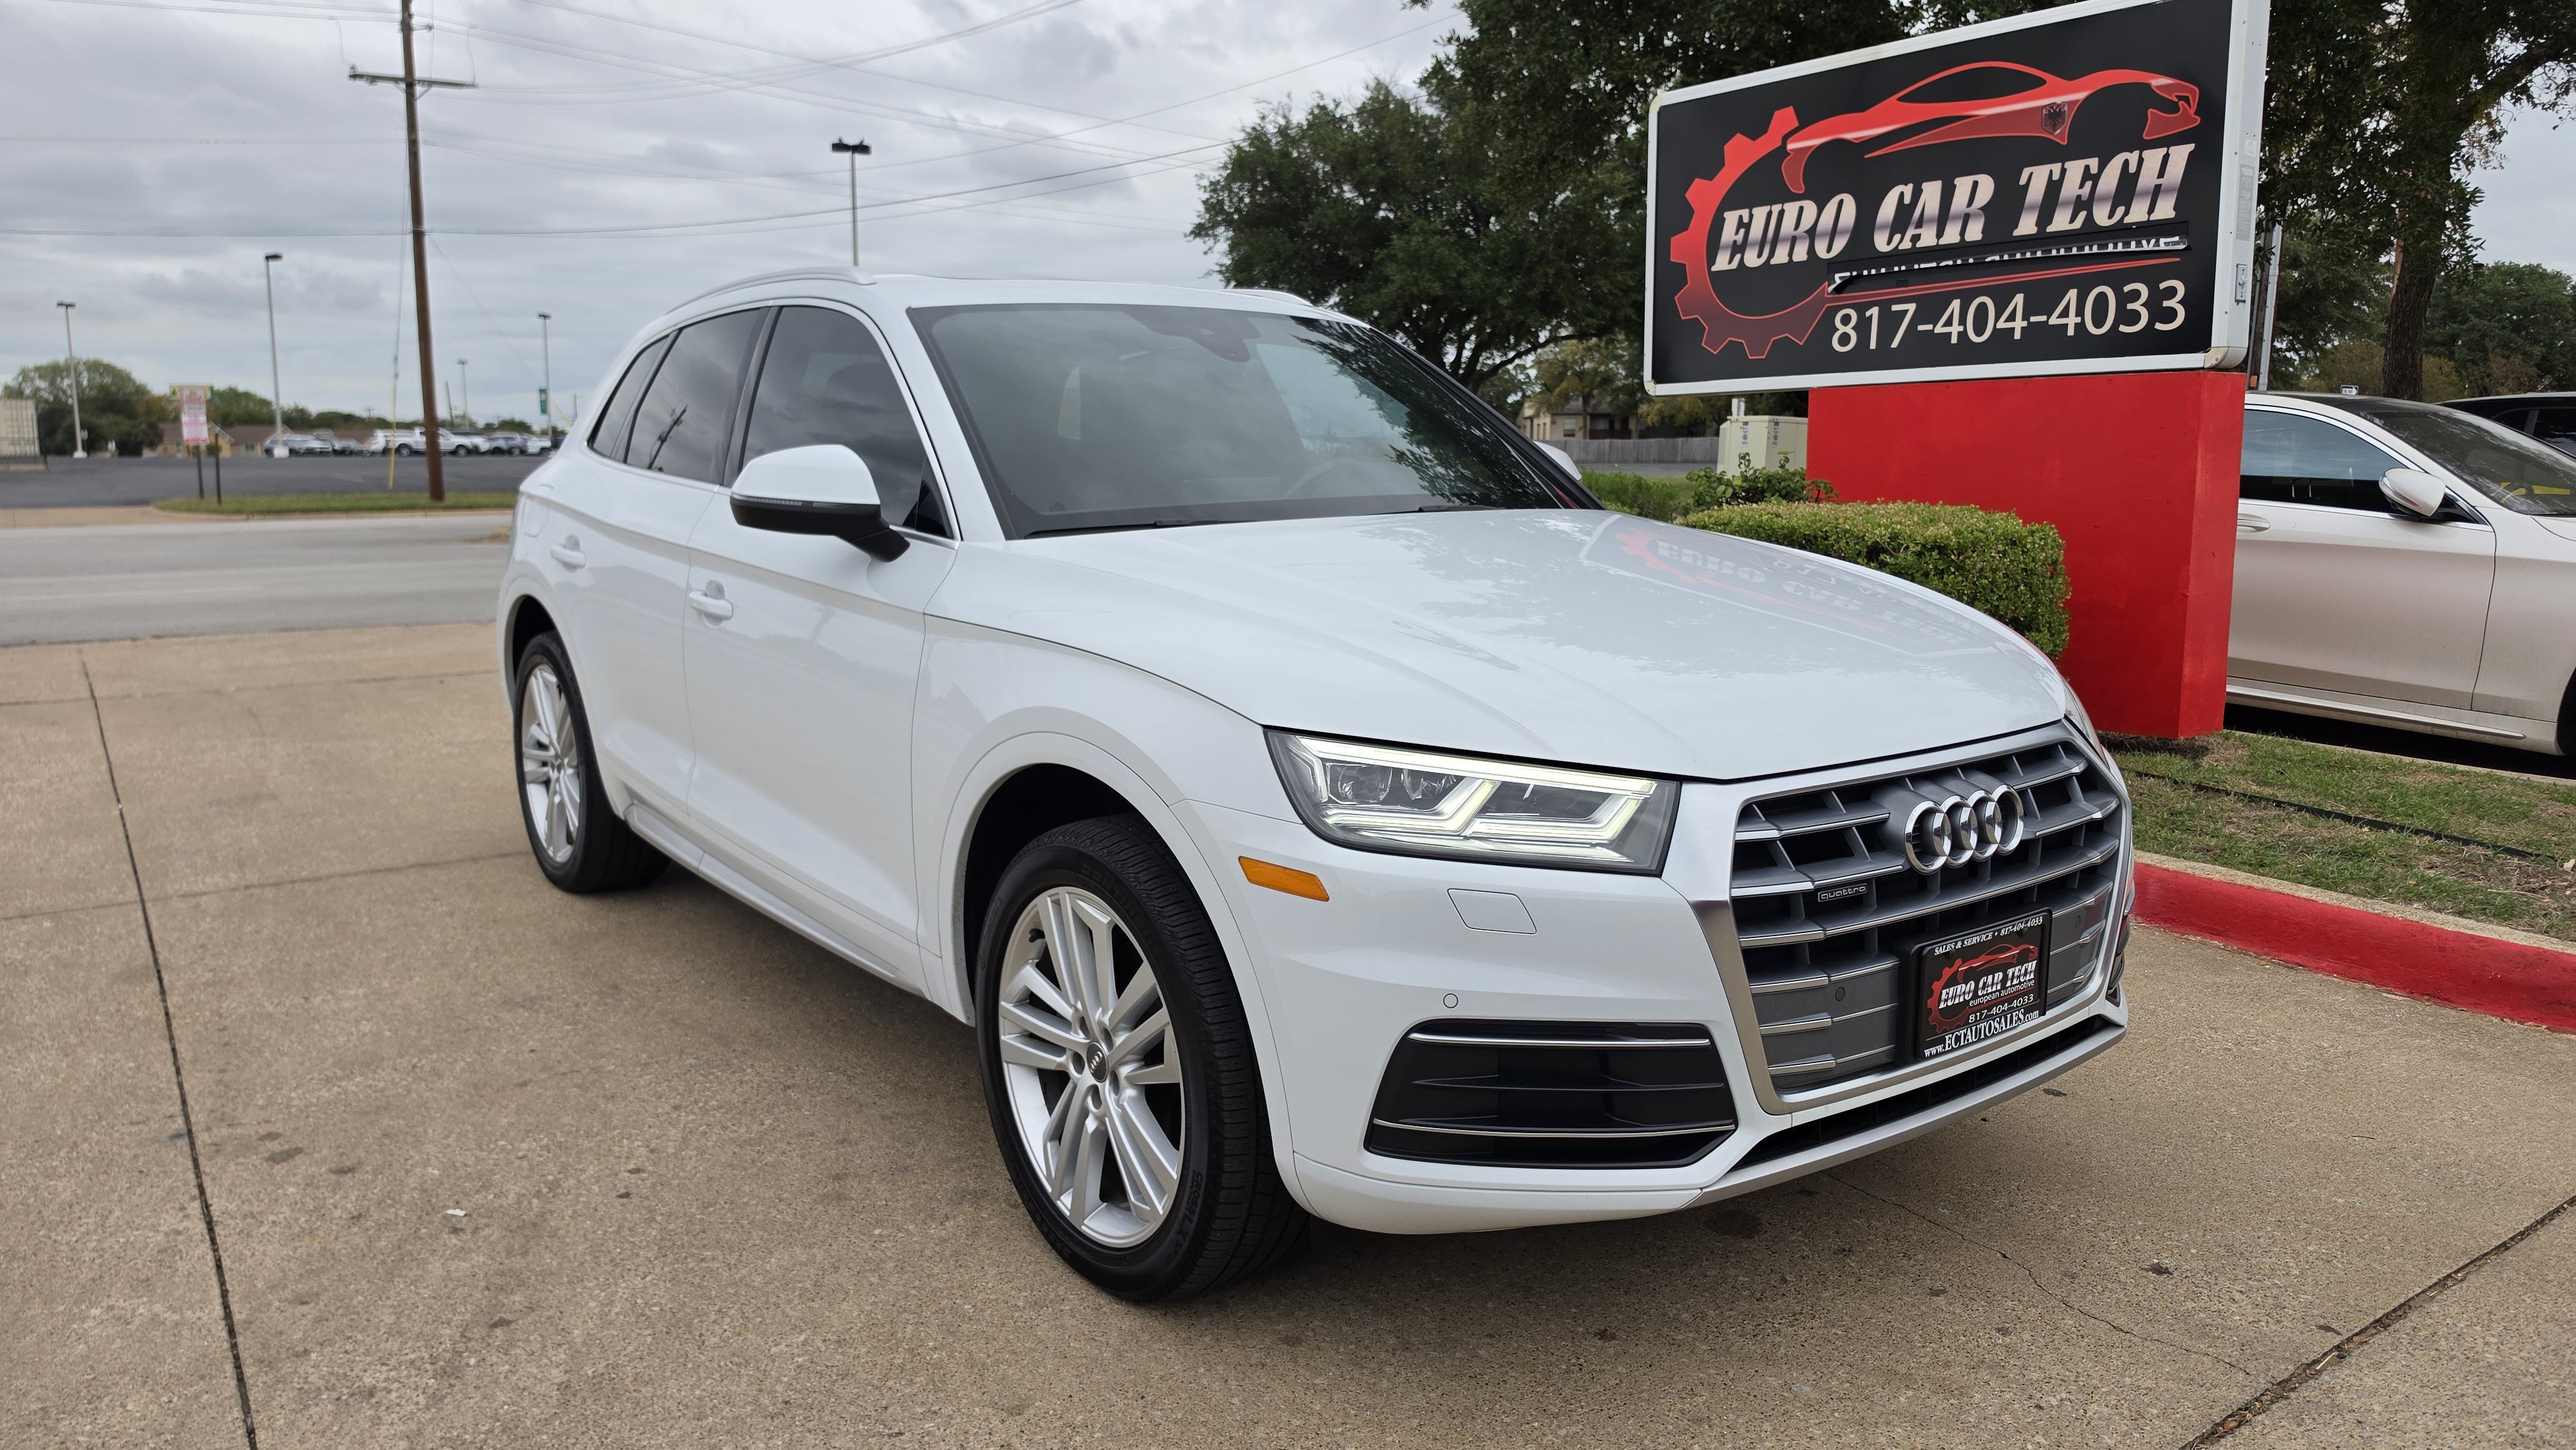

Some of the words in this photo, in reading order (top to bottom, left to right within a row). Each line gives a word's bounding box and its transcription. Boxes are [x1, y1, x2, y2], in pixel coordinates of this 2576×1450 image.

[1711, 193, 1857, 272] EURO
[1873, 174, 1995, 253] CAR
[2012, 144, 2195, 236] TECH
[1832, 279, 2186, 352] 817-404-4033
[1821, 886, 1866, 900] quattro
[1934, 942, 1956, 956] SALES
[1955, 940, 1962, 949] &
[1963, 932, 1993, 947] SERVICE
[2000, 916, 2043, 936] 817-404-4033
[1938, 980, 1975, 1009] EURO
[1978, 972, 2003, 995] CAR
[2006, 960, 2037, 986] TECH
[1968, 993, 2034, 1023] 817-404-4033
[1969, 992, 2000, 1007] european
[2000, 979, 2035, 997] automotive
[1924, 1009, 2039, 1058] www.ECTAUTOSALES.com
[1189, 1171, 1204, 1218] CROSS
